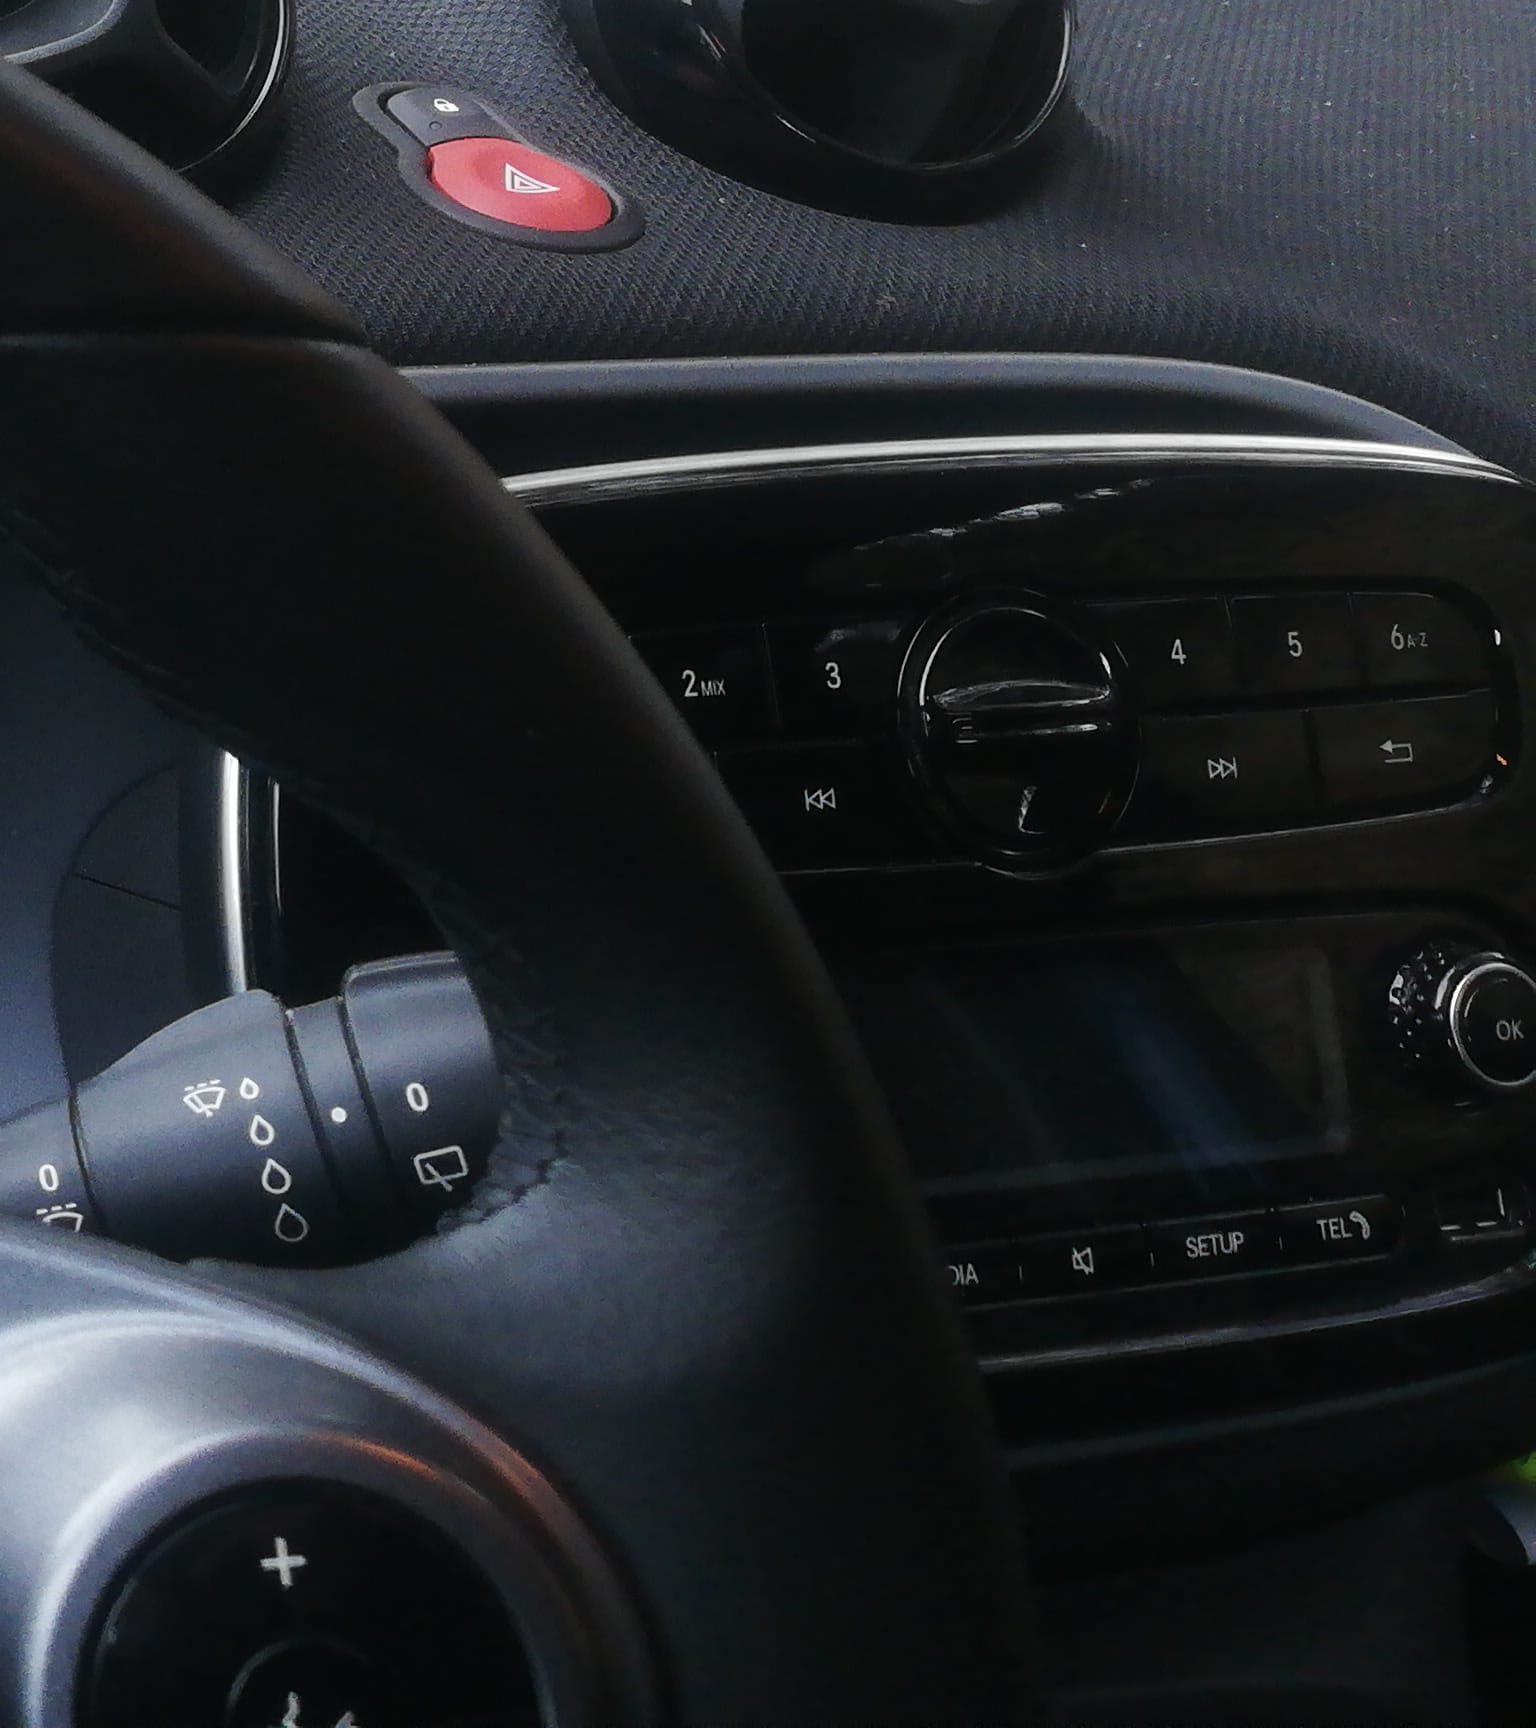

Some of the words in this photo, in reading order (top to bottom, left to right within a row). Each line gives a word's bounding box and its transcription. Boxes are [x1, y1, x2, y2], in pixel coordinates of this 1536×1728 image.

[1170, 638, 1187, 665] 4
[1287, 631, 1303, 657] 5
[824, 661, 842, 689] 3
[1495, 1018, 1525, 1042] OK
[406, 1082, 429, 1112] 0
[37, 1163, 60, 1191] 0
[1316, 1217, 1350, 1241] TEL
[1185, 1230, 1245, 1259] SETUP
